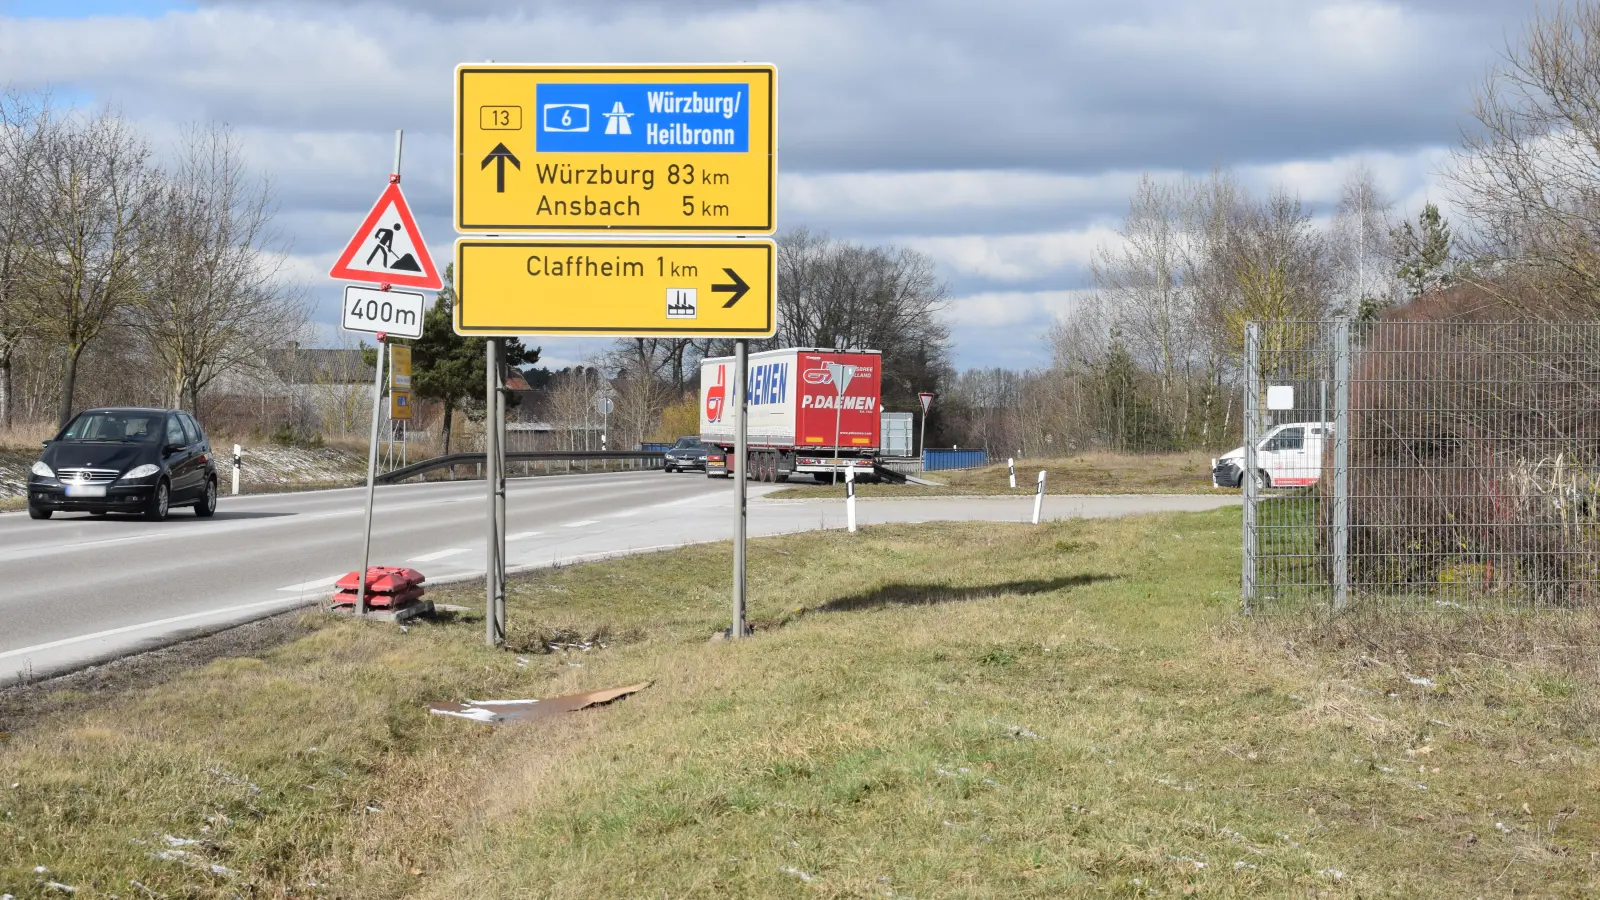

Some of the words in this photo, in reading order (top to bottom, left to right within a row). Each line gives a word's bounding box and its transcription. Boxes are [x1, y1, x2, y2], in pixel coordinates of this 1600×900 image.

[647, 91, 742, 118] Würzburg/
[492, 110, 509, 126] 13
[561, 110, 572, 126] 6
[646, 123, 735, 146] Heilbronn
[536, 163, 654, 190] Würzburg
[667, 164, 695, 185] 83
[702, 169, 729, 185] km
[535, 195, 640, 216] Ansbach
[682, 196, 695, 216] 5
[702, 201, 729, 216] km
[526, 255, 644, 277] Claffheim
[656, 256, 664, 276] 1
[671, 261, 698, 277] km
[351, 298, 416, 325] 400m
[801, 394, 876, 410] P.DAEMEN
